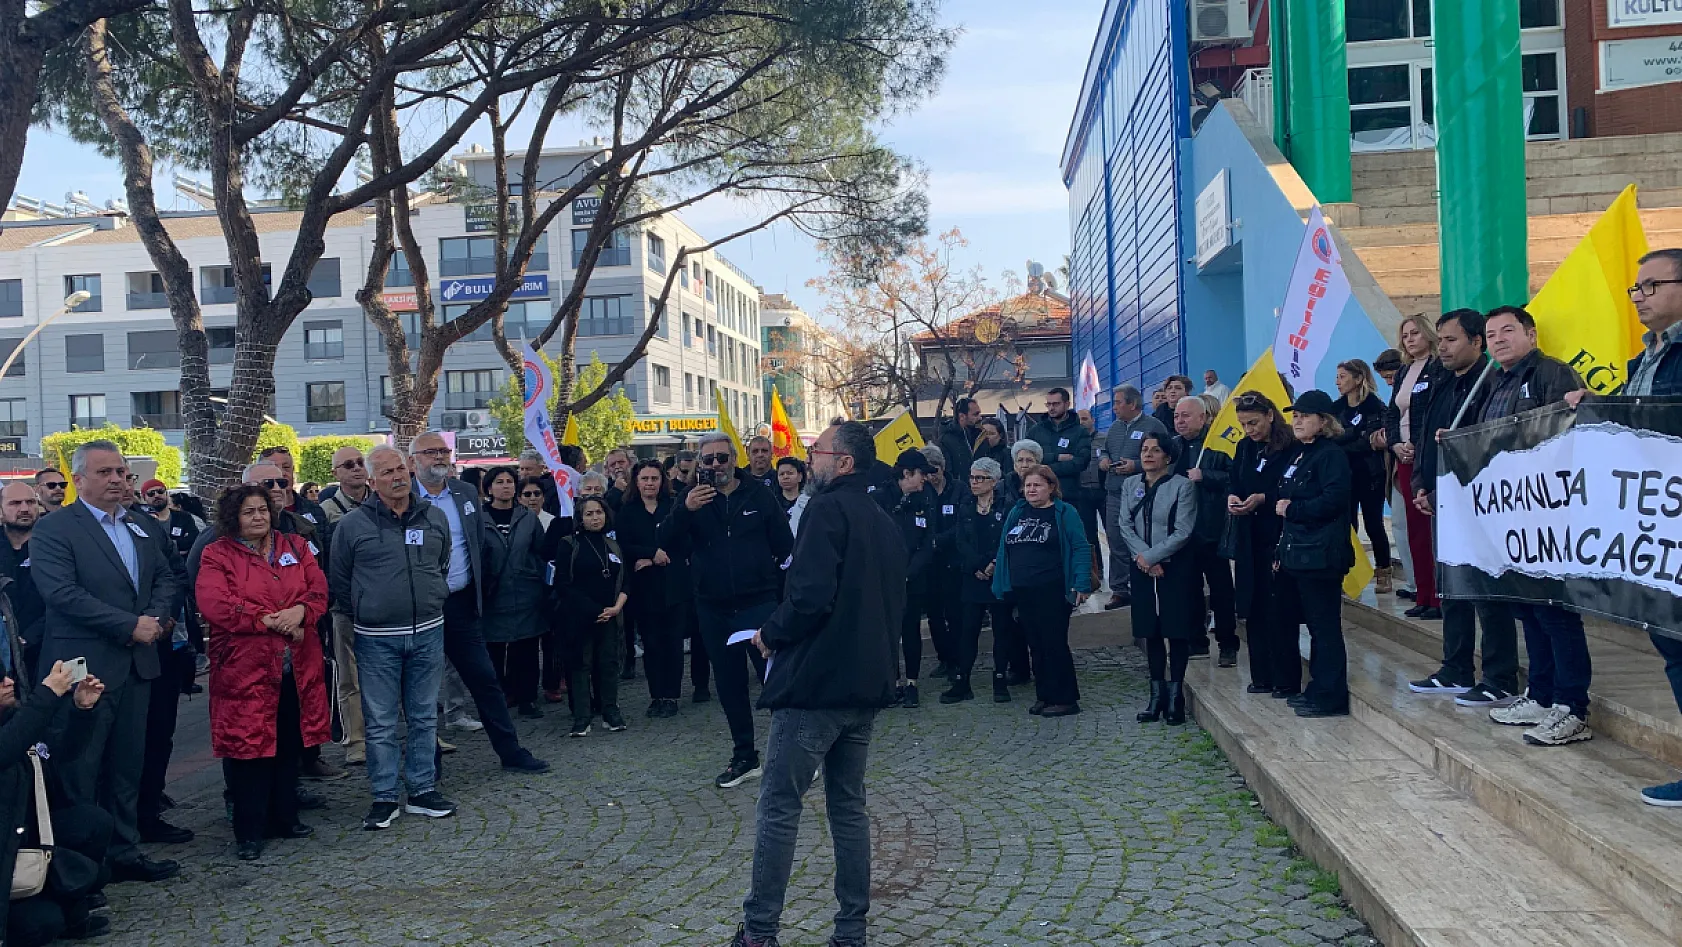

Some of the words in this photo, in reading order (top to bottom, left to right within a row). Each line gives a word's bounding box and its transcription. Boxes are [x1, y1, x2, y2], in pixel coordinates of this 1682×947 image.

[1643, 57, 1682, 66] www.
[576, 198, 602, 208] AVU
[669, 417, 718, 431] BURGER
[469, 438, 490, 449] FOR
[491, 437, 507, 448] YO
[1611, 470, 1682, 518] TES
